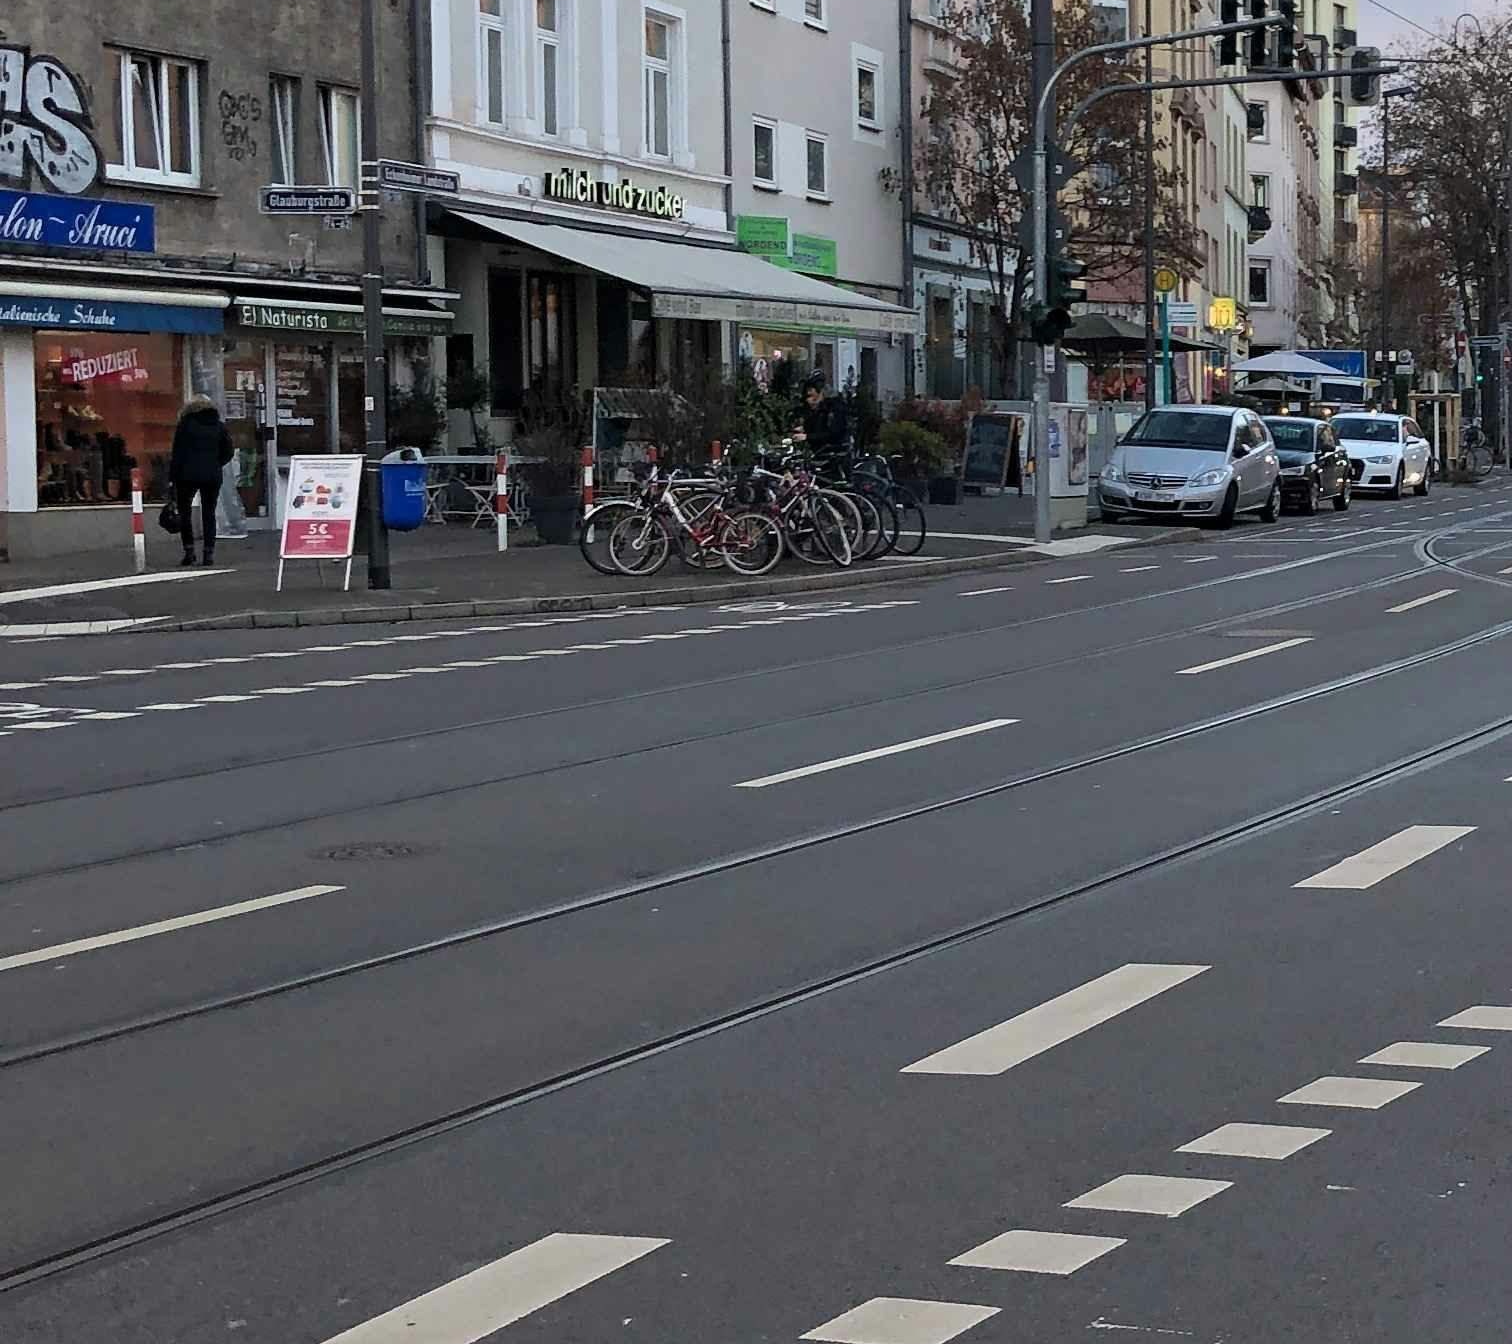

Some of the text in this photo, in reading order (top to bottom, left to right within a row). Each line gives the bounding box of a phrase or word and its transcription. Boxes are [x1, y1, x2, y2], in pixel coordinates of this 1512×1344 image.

[269, 194, 346, 211] Glauburgstraße
[550, 168, 688, 219] milch und zucker
[68, 205, 141, 248] Aruci
[1159, 275, 1169, 285] H
[68, 304, 116, 326] Schuhe
[242, 305, 256, 325] El
[261, 306, 328, 329] Naturista
[72, 348, 138, 382] REDUZIERT
[308, 523, 329, 534] 5€
